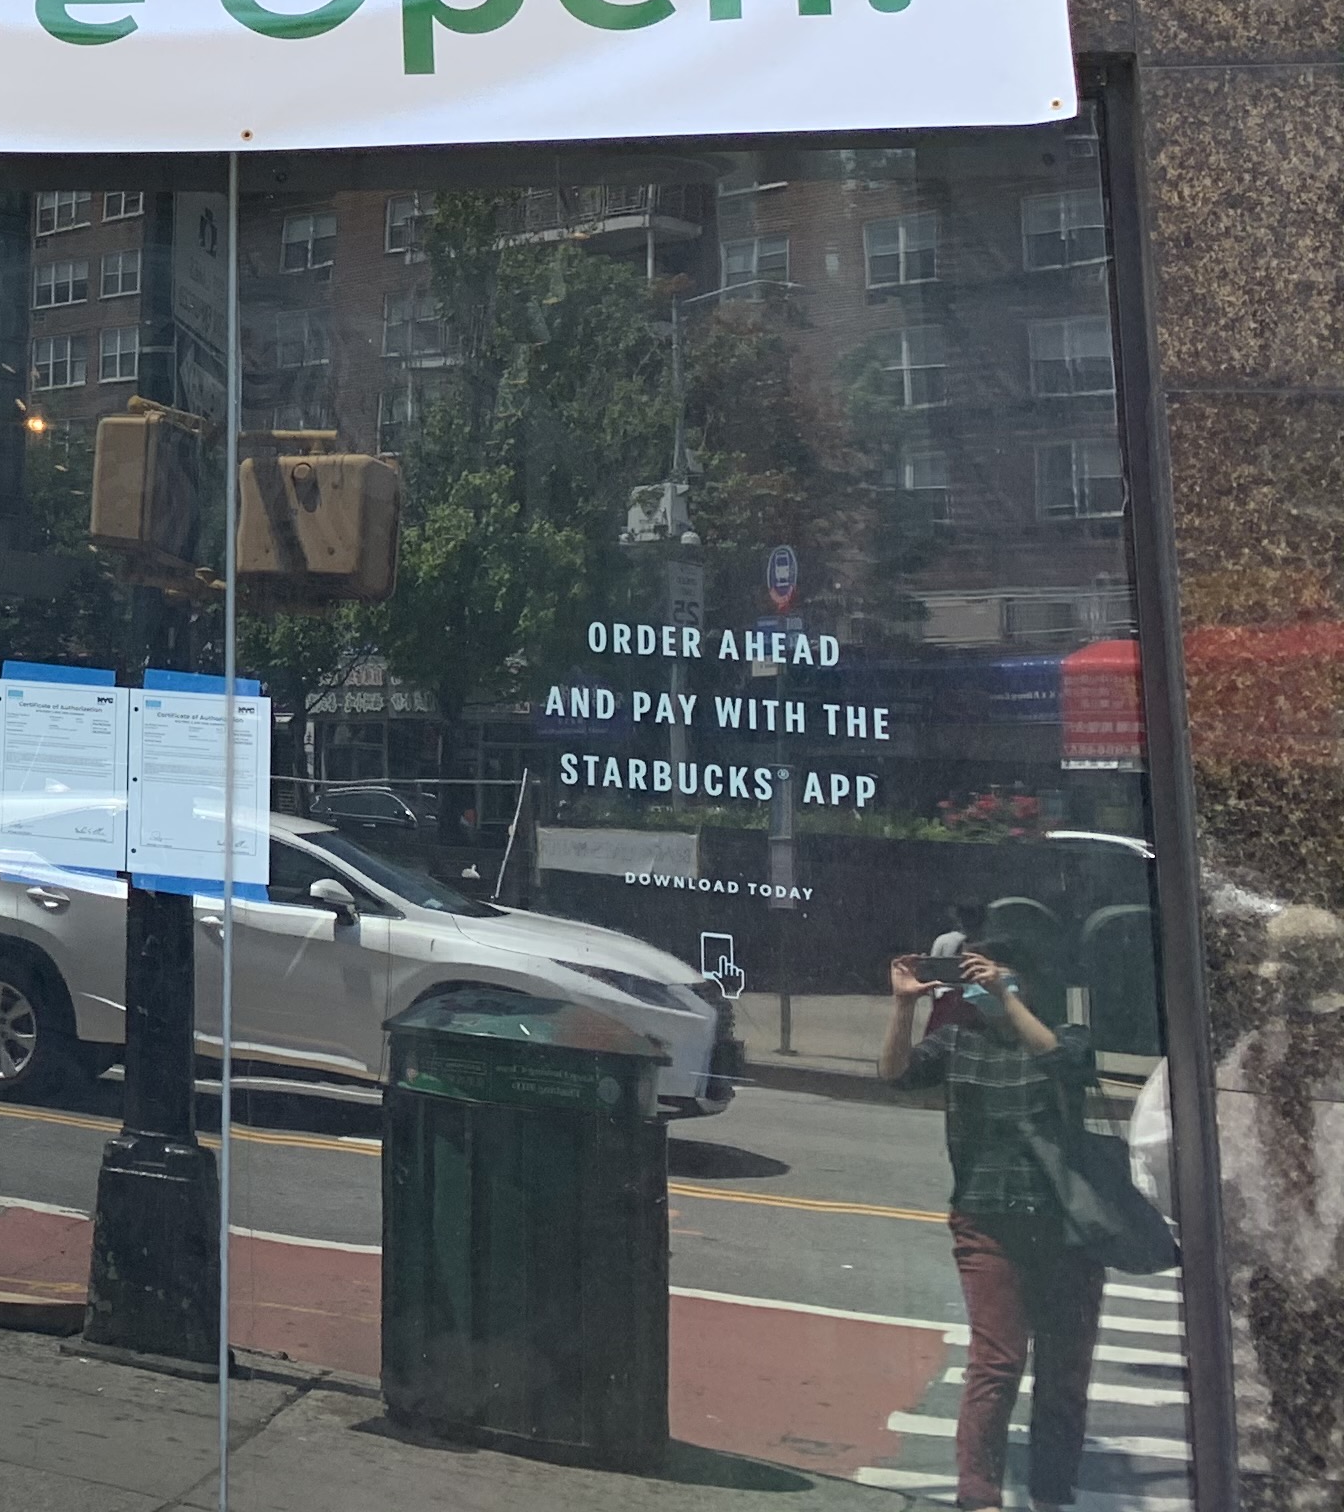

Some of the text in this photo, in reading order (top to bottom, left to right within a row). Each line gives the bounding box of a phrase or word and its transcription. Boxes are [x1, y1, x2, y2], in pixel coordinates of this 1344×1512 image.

[588, 621, 840, 667] ORDER AHEAD
[545, 686, 890, 740] AND PAY WITH THE
[803, 772, 876, 807] APP
[625, 871, 813, 900] DOWNLOAD TODAY
